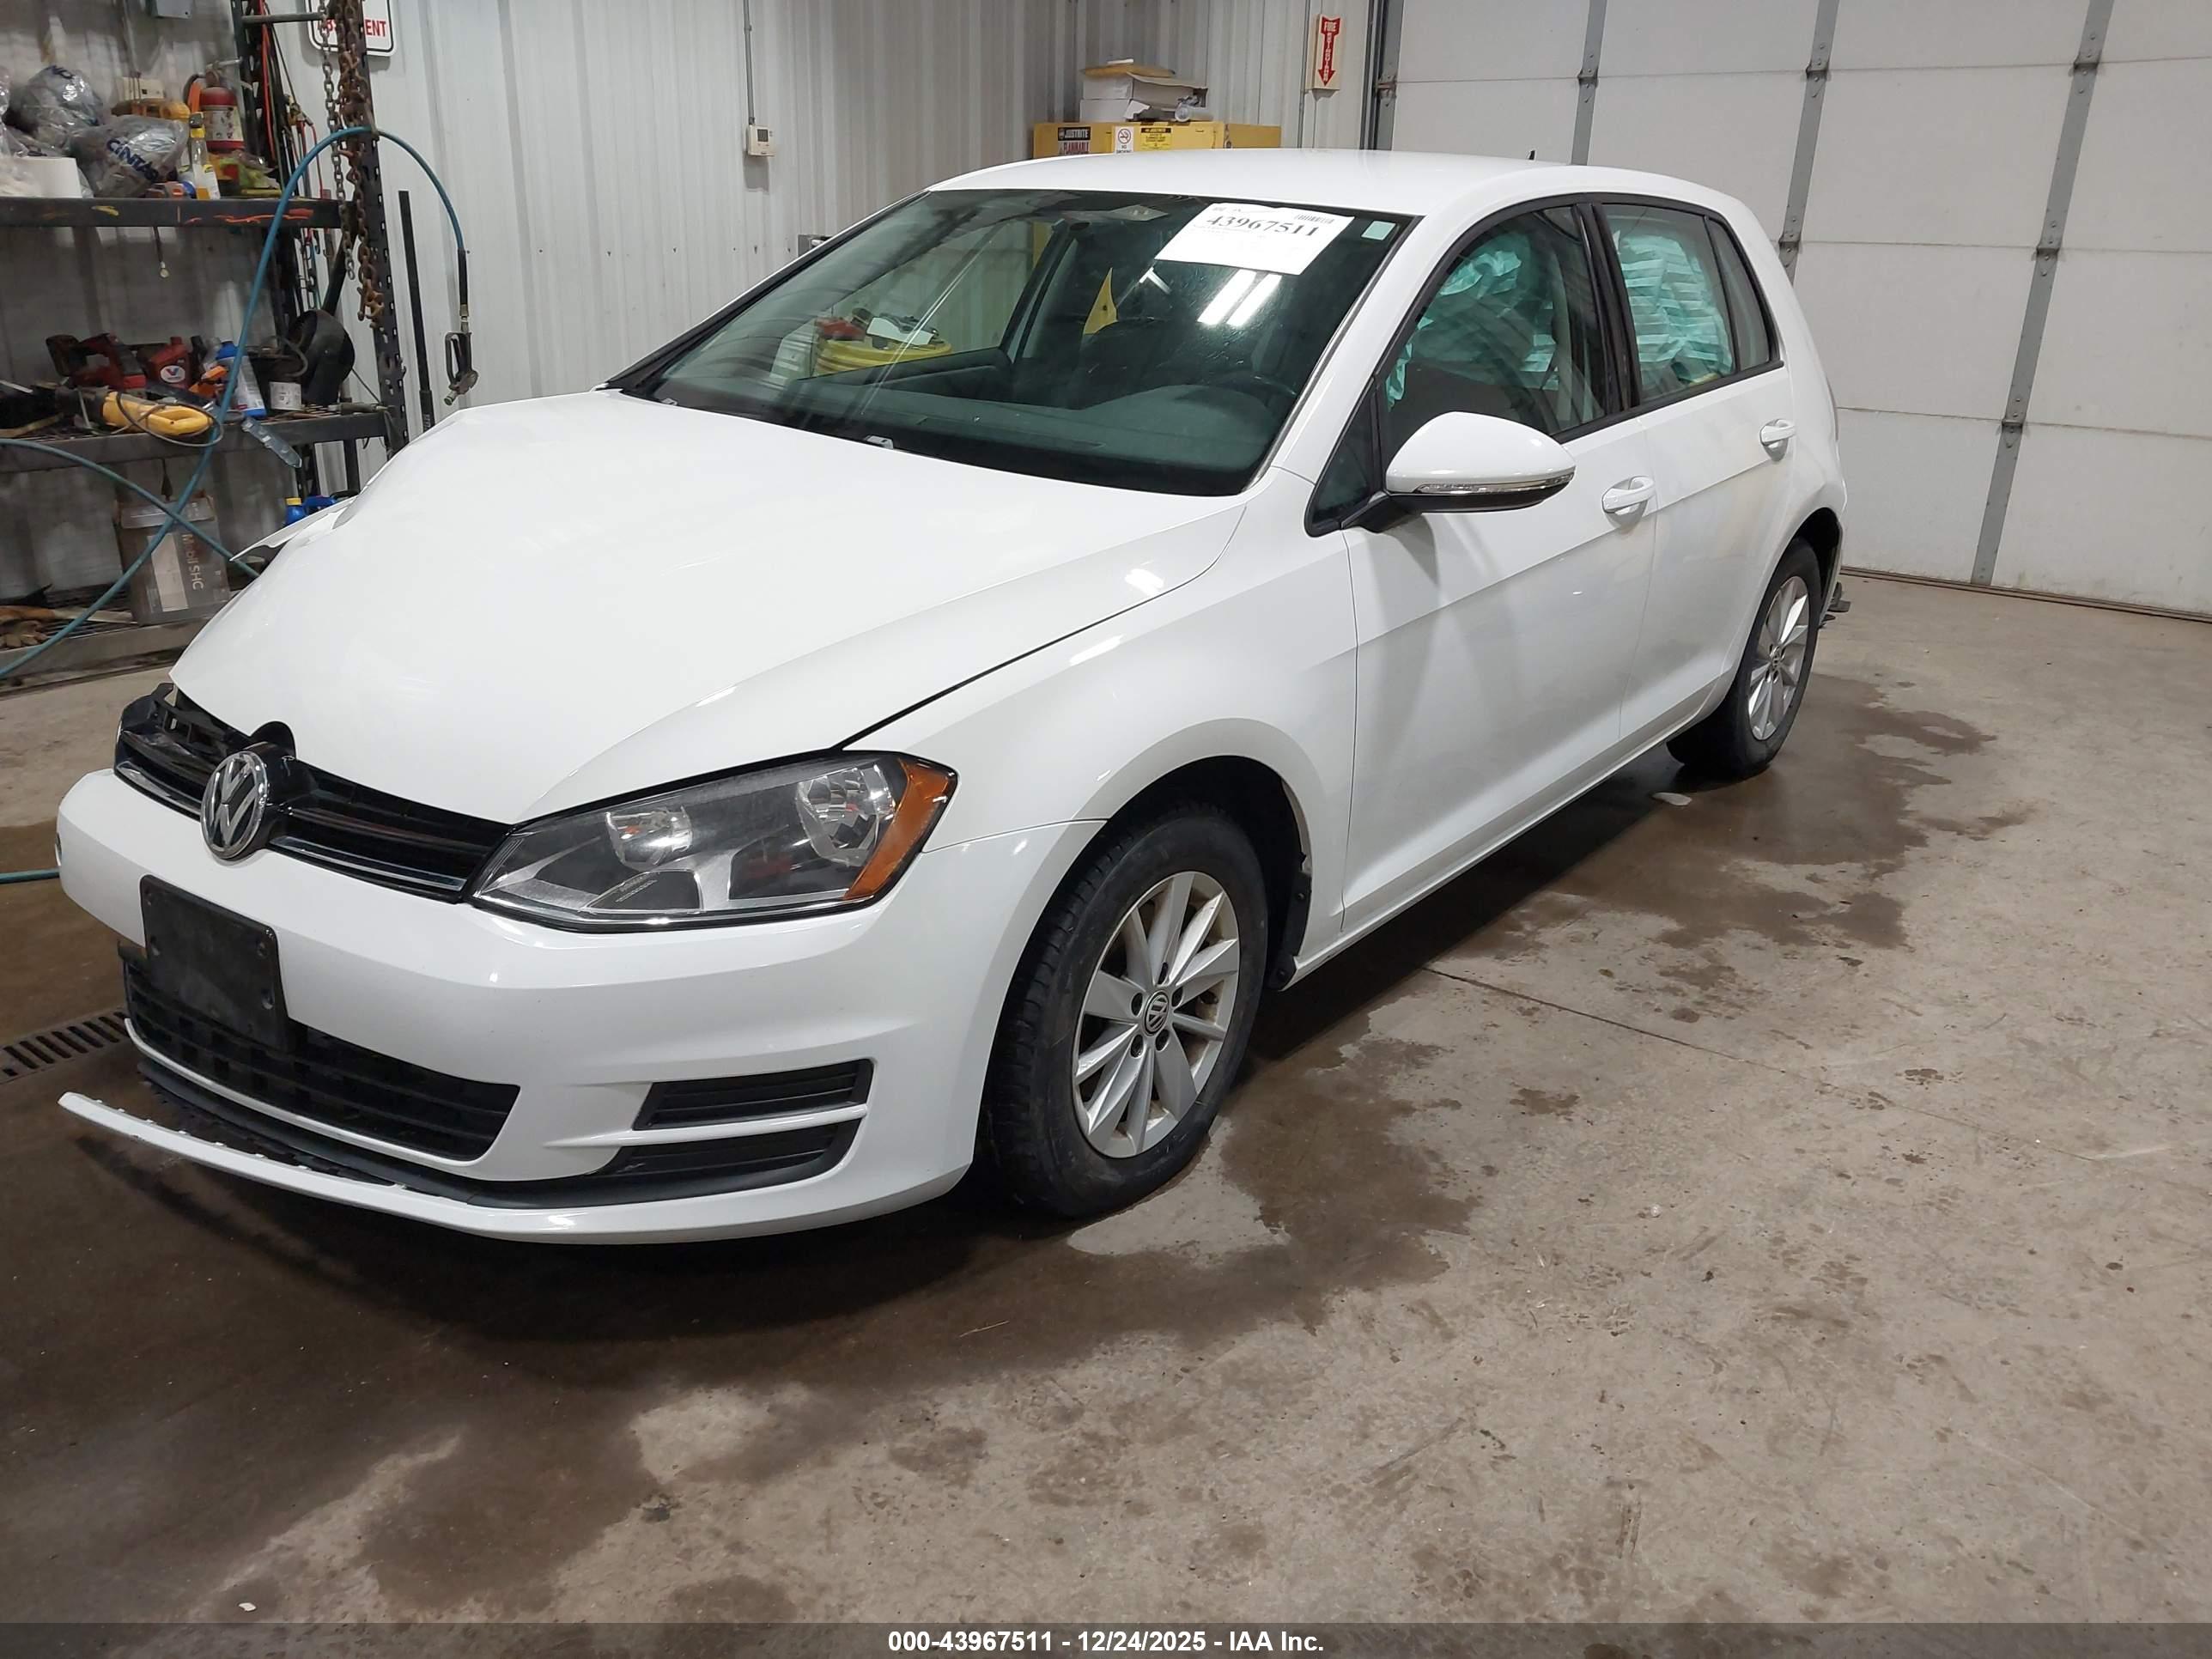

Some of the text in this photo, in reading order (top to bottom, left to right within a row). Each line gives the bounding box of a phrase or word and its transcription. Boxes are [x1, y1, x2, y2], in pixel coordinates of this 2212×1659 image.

[1324, 21, 1337, 32] FIRE
[1206, 216, 1319, 236] 43967511
[190, 565, 204, 590] SHC
